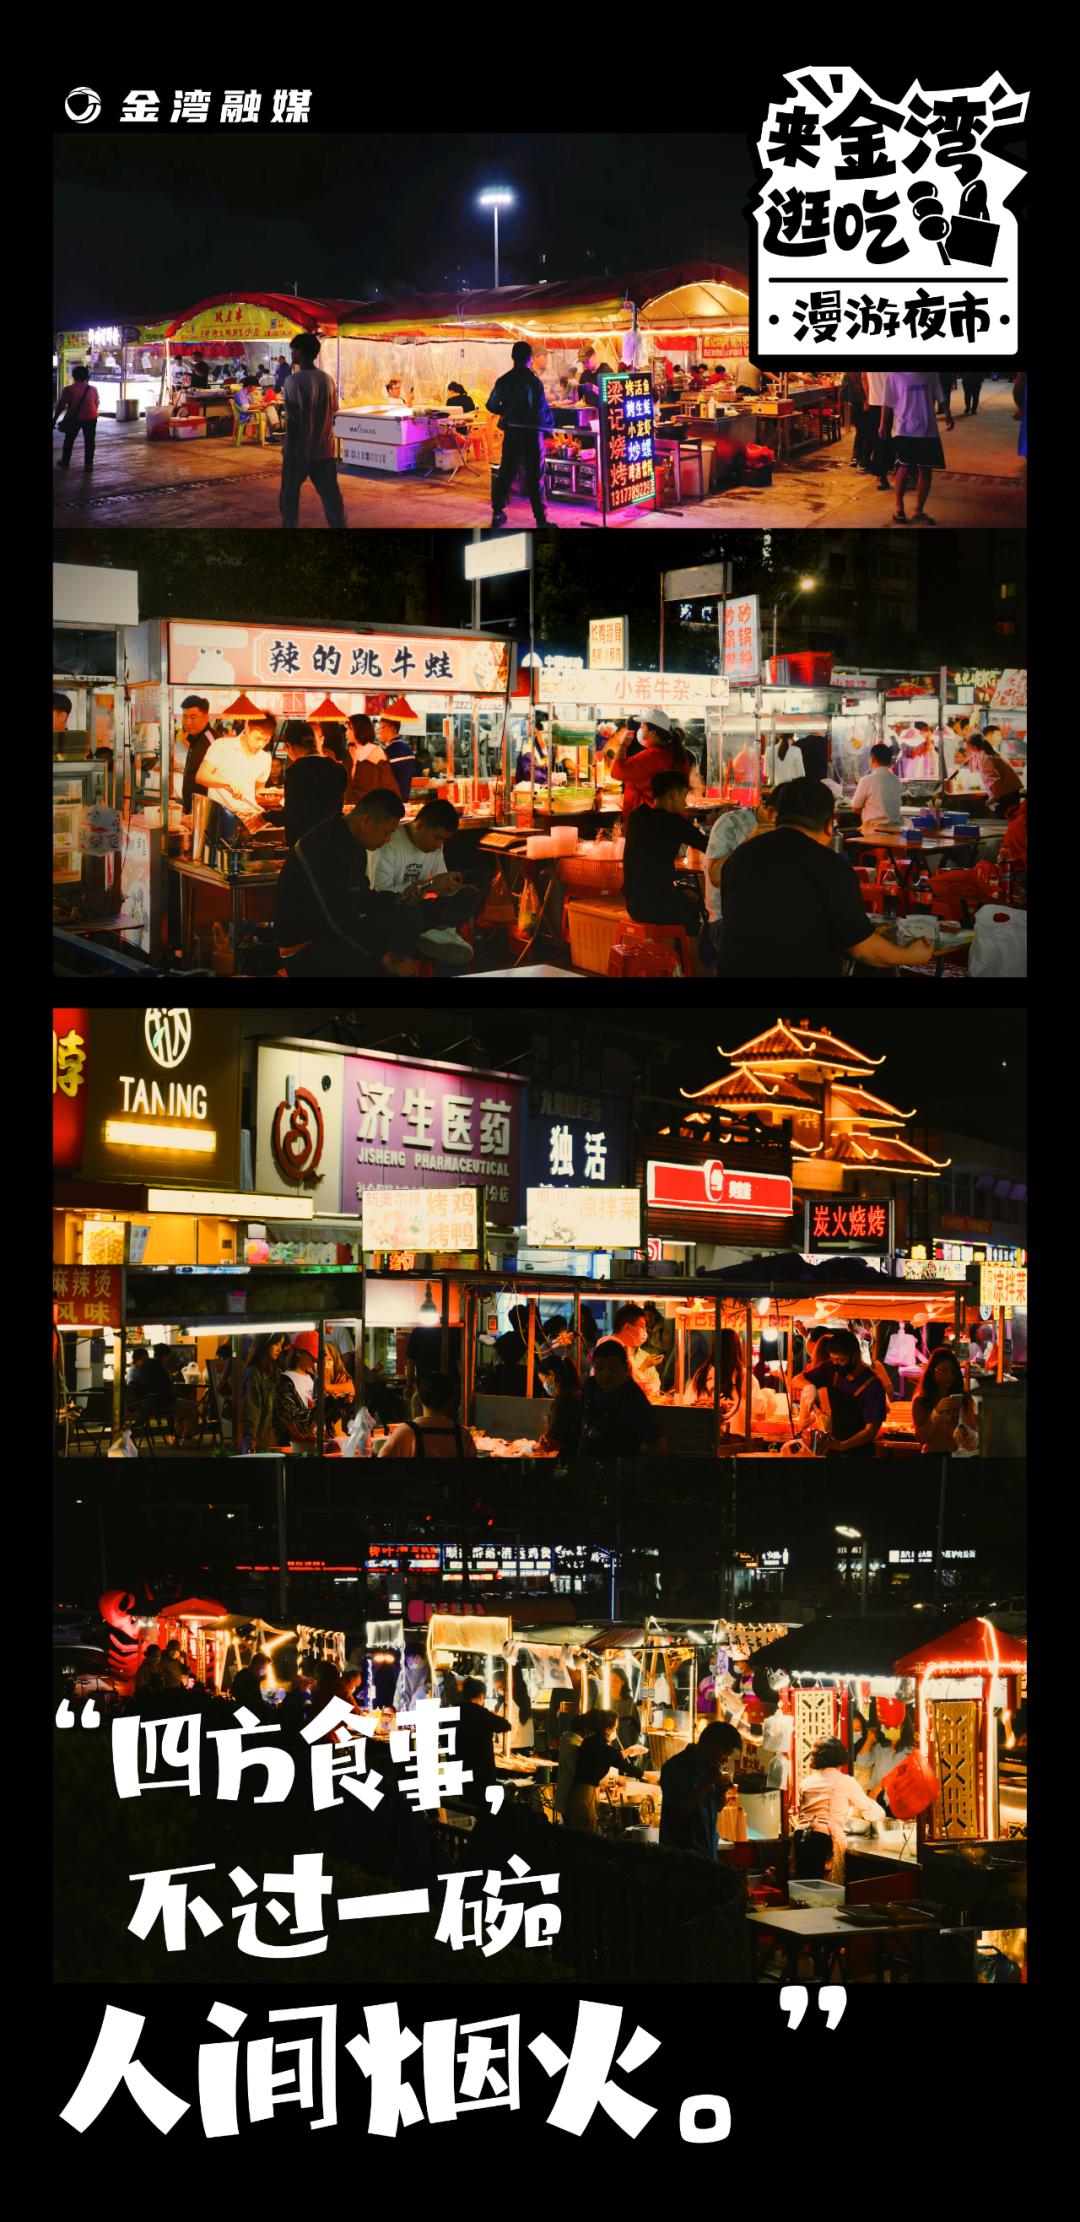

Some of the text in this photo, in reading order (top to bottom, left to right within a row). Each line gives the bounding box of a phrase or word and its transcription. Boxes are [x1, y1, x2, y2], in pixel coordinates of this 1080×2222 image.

[607, 380, 628, 488] 梁记烧烤
[268, 639, 454, 682] 辣的跳牛蛙
[614, 675, 690, 701] 小希牛杂
[119, 1075, 208, 1120] TANING
[357, 1080, 513, 1156] 济生医药
[357, 1147, 510, 1177] JISHENG PHARMACEUTICAL
[549, 1124, 608, 1180] 独活
[426, 1190, 475, 1217] 烤鸡
[578, 1195, 639, 1220] 凉拌菜
[427, 1221, 474, 1247] 烤鸭
[813, 1205, 886, 1238] 炭火烧烤
[53, 1268, 112, 1298] 麻辣烫
[993, 1269, 1026, 1304] 凉拌菜
[58, 1301, 112, 1324] 风味
